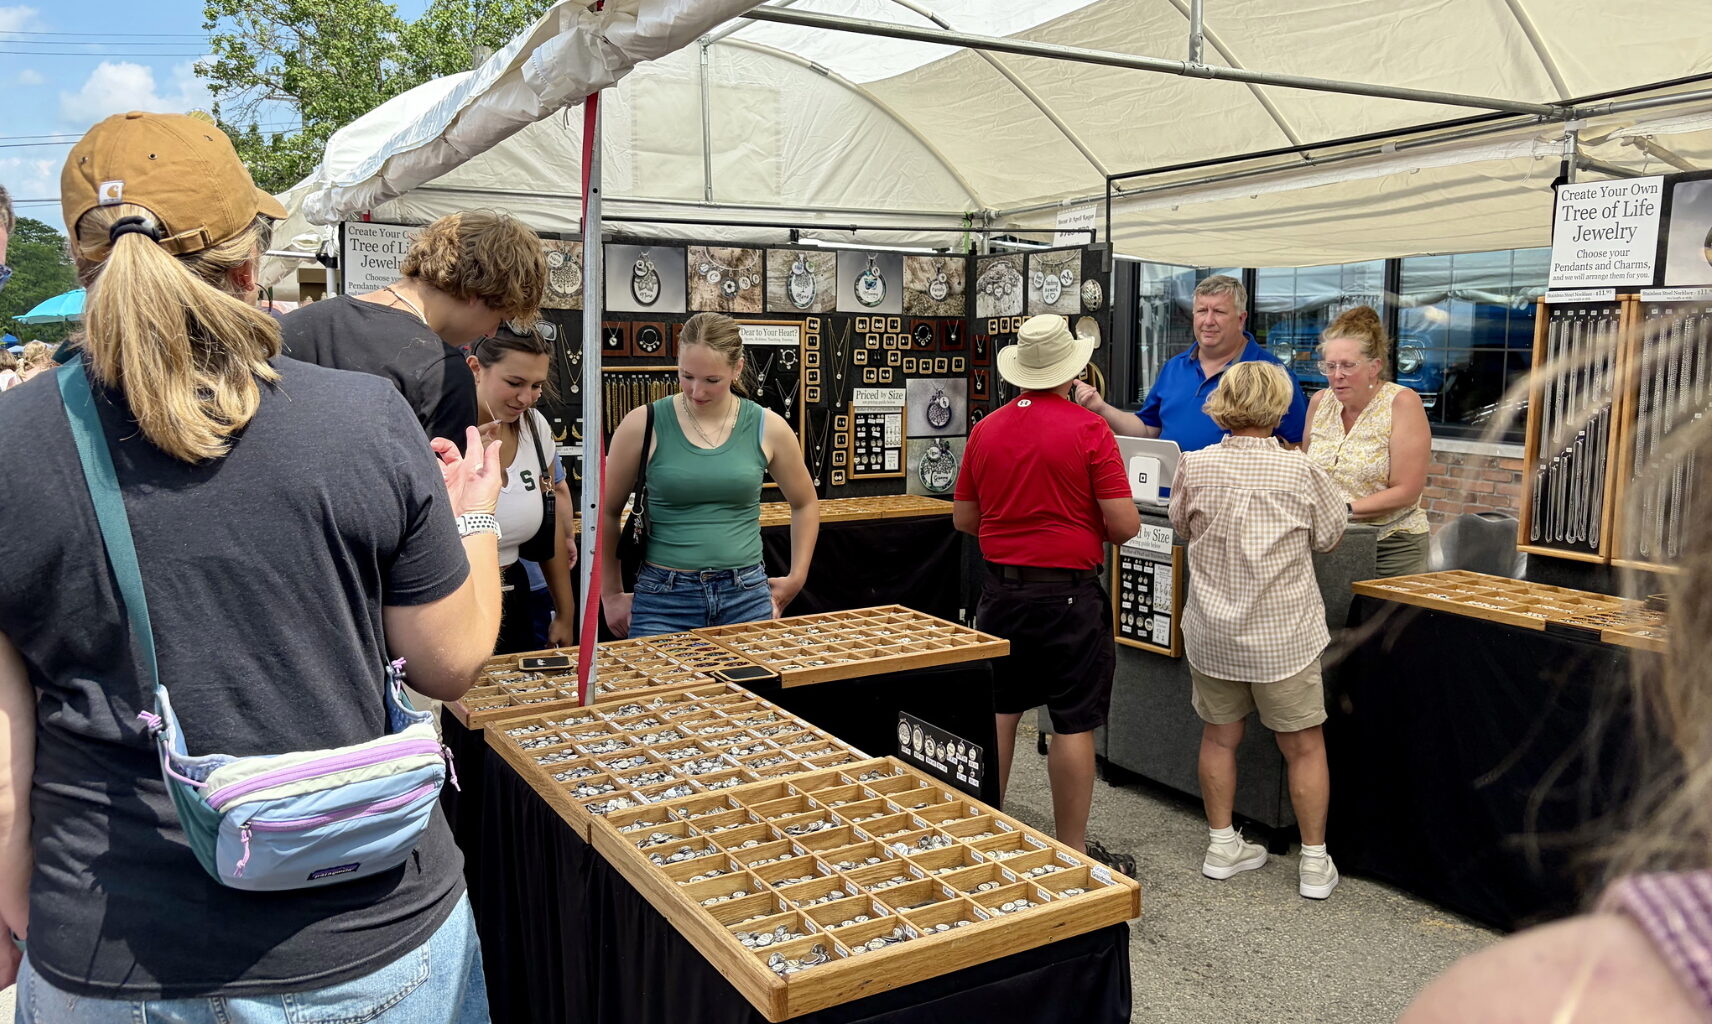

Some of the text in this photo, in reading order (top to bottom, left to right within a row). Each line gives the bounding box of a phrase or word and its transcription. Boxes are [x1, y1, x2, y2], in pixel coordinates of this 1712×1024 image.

[1561, 183, 1658, 201] Create Your Own
[1562, 198, 1655, 221] Tree of Life
[348, 226, 377, 237] Create
[379, 229, 400, 238] Your
[1572, 222, 1638, 243] Jewelry
[350, 238, 409, 254] Tree of Li
[1576, 249, 1630, 259] Choose your
[361, 255, 401, 269] Jewelr
[1554, 260, 1651, 272] Pendants and Charms,
[365, 273, 390, 281] Choose
[348, 282, 379, 290] Pendants
[741, 328, 755, 336] Dear
[779, 329, 798, 337] Heart?
[856, 390, 903, 400] Priced by Size
[520, 470, 536, 491] S
[1144, 528, 1151, 539] by
[1152, 529, 1169, 543] Size
